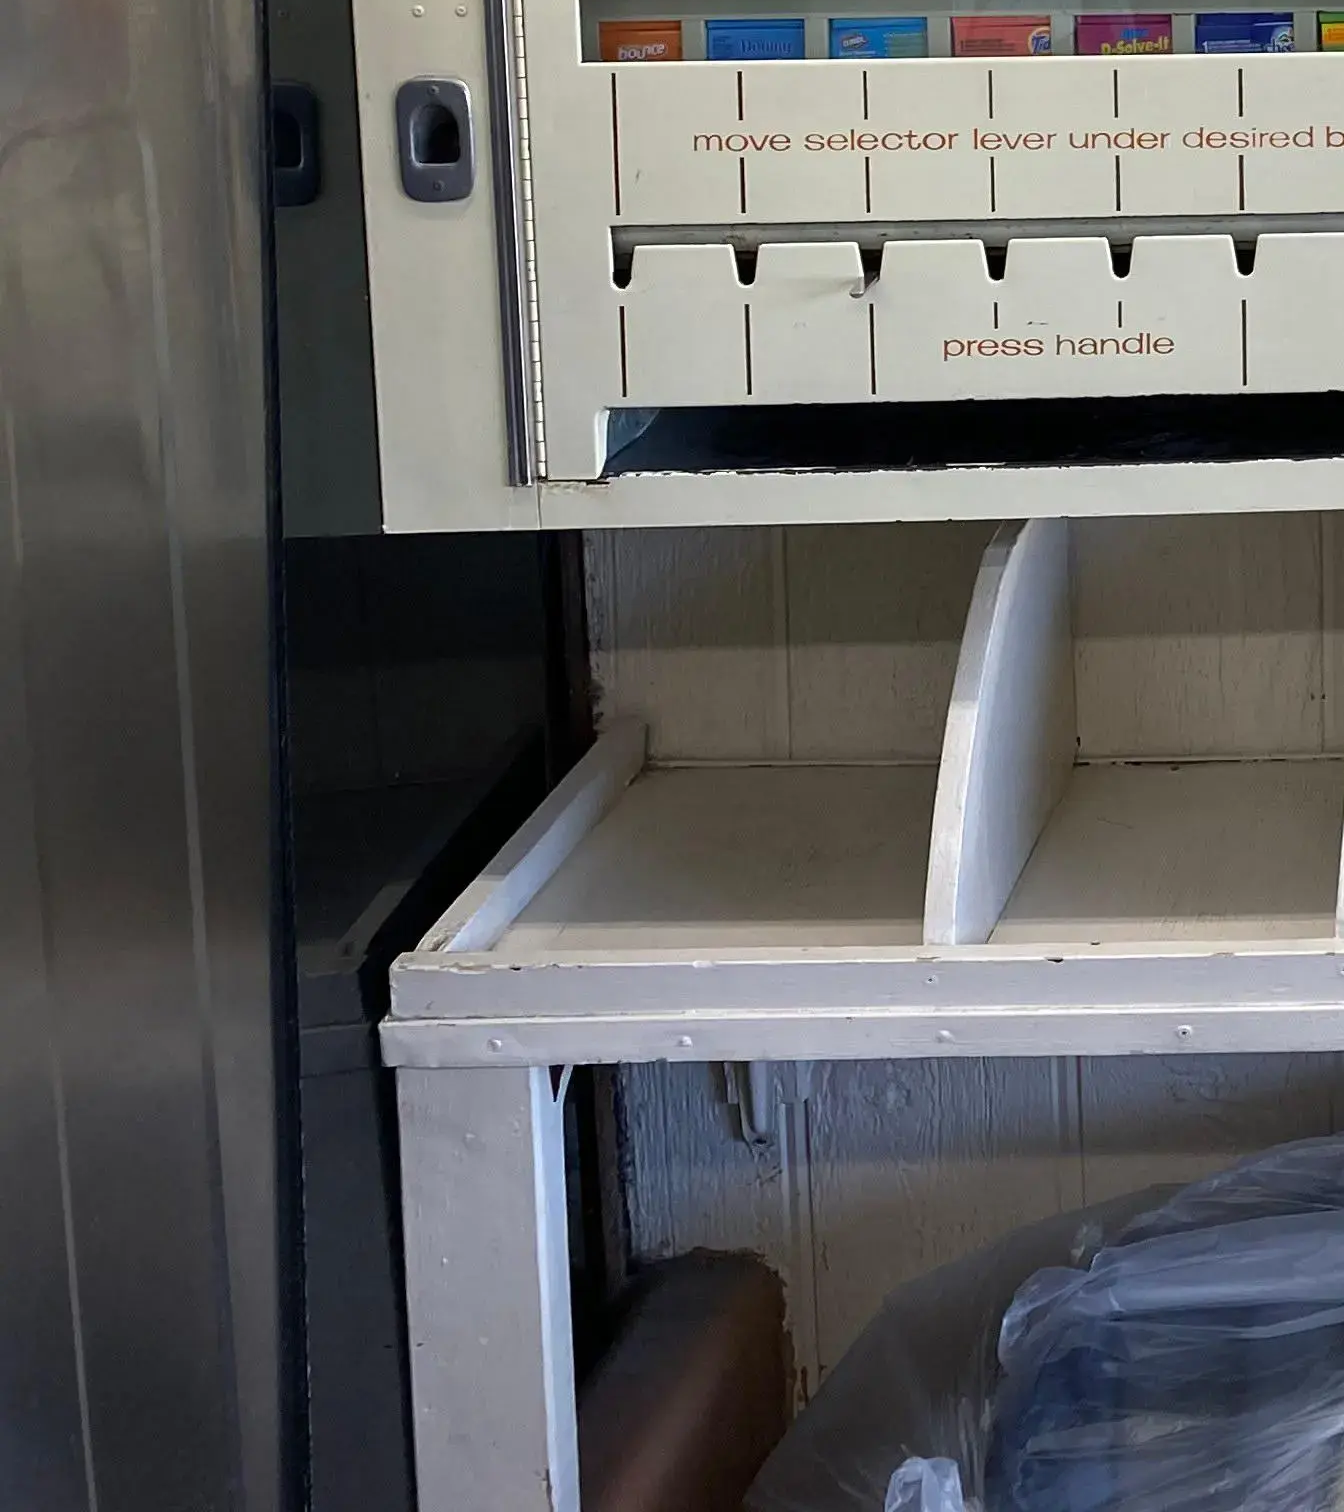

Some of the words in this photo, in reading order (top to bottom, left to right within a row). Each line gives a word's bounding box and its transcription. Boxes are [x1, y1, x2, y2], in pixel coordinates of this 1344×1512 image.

[692, 132, 791, 152] move
[804, 128, 958, 152] selector
[972, 128, 1058, 151] lever
[1068, 128, 1170, 150] under
[1182, 126, 1314, 149] desired
[943, 338, 1044, 362] press
[1055, 332, 1176, 356] handle
